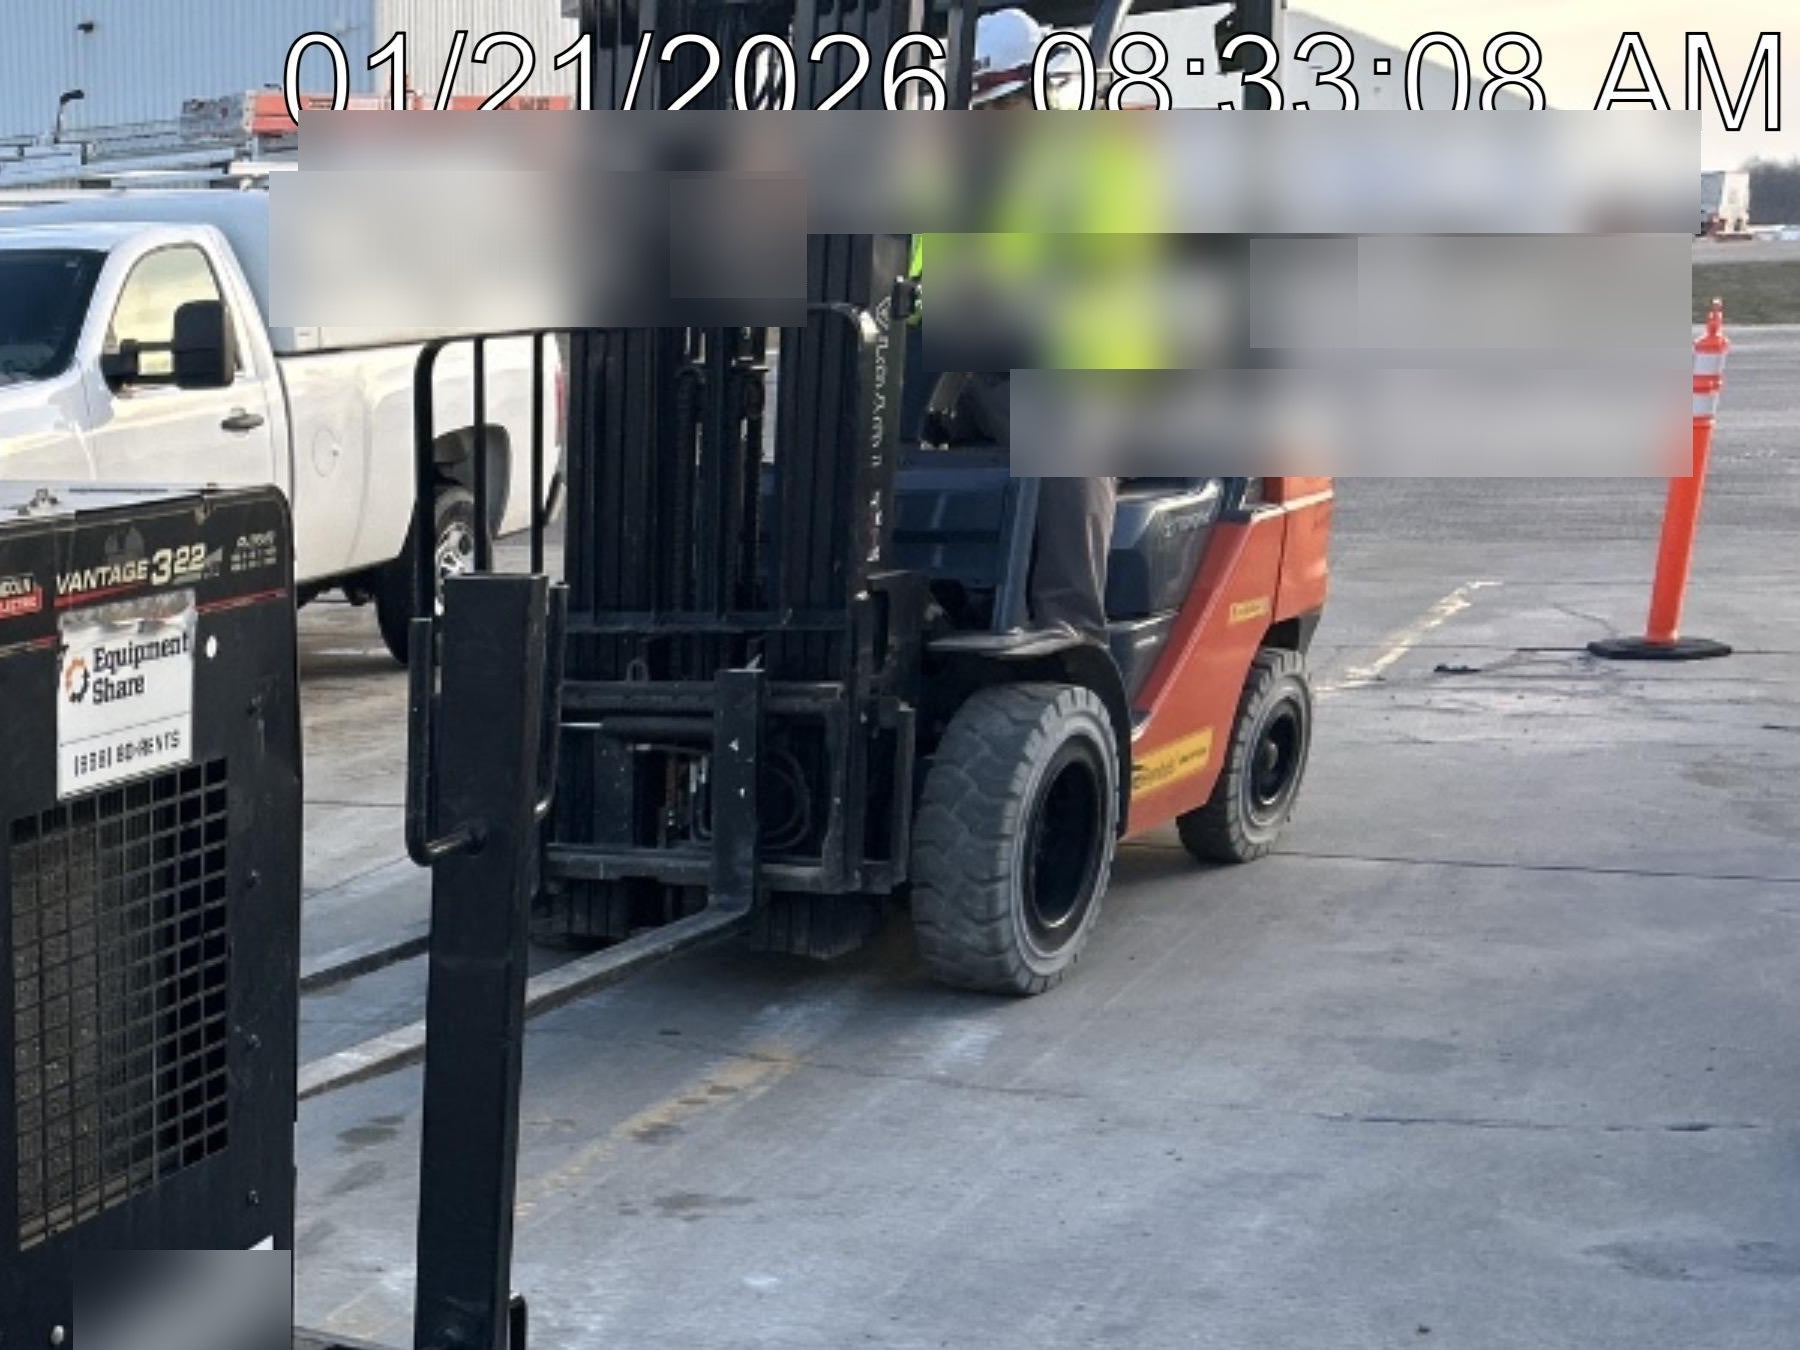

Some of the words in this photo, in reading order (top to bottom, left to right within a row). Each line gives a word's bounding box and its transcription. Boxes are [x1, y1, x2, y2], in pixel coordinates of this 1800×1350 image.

[55, 559, 149, 596] VANTAGE
[149, 541, 207, 587] 322
[92, 634, 190, 677] Equipment
[92, 672, 145, 706] Share
